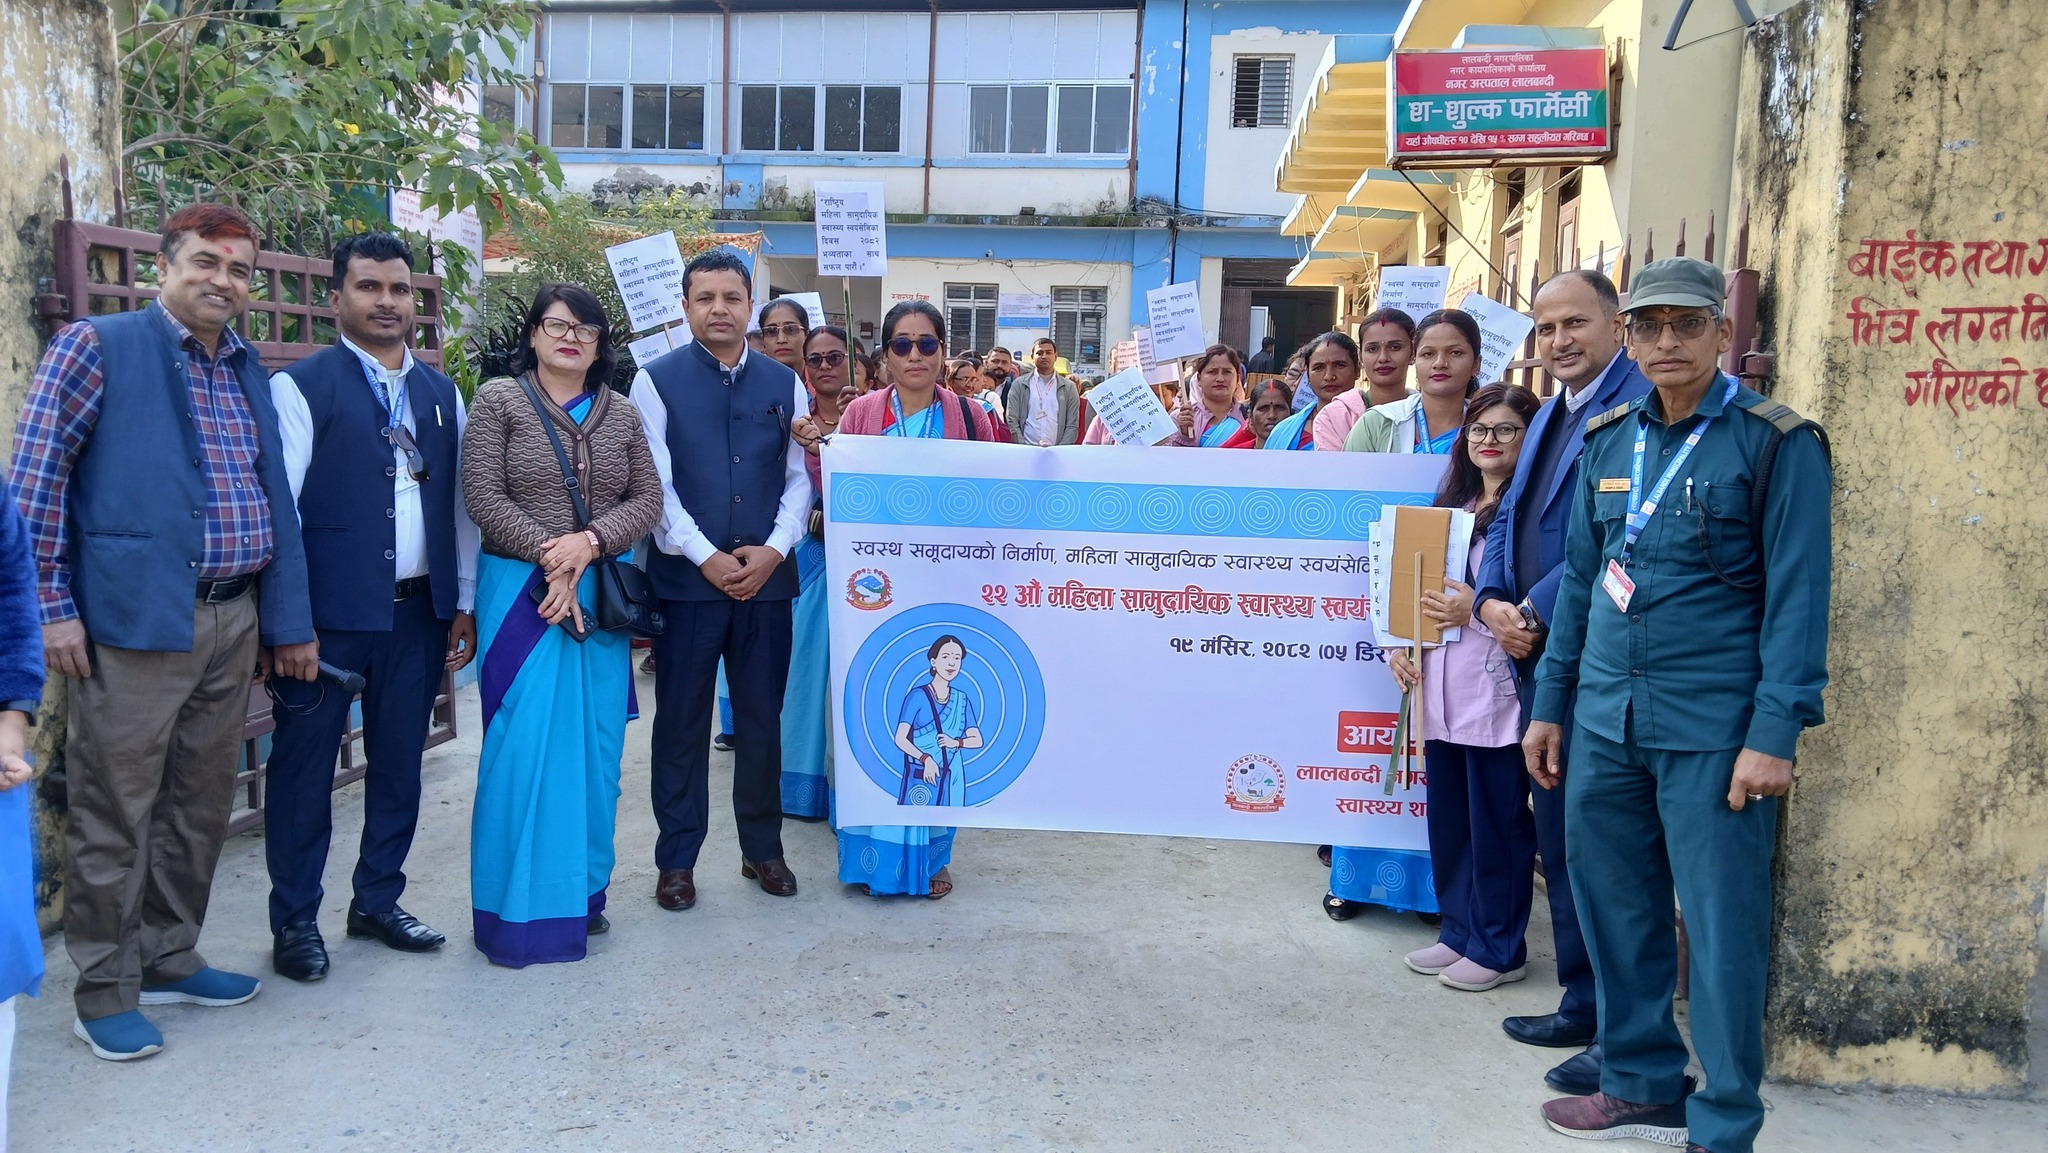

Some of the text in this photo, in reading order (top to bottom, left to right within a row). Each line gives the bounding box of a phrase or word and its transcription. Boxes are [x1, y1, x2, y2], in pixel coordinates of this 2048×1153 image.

[1450, 67, 1466, 75] नगर
[1518, 62, 1546, 72] कार्यालय
[1461, 53, 1534, 64] लालबन्दी नगरपालिका
[1445, 74, 1555, 89] नगर अस्पताल लालबन्दी
[1509, 91, 1592, 118] फार्मेसी
[1459, 135, 1468, 144] १०
[1470, 133, 1486, 144] देखि
[1508, 134, 1526, 143] सम्म
[821, 209, 878, 221] महिला सामुदायिक
[821, 235, 840, 245] दिवस
[1963, 240, 2029, 288] तथा
[1847, 296, 1920, 348] भित्र
[1905, 357, 2029, 417] गरिएको
[852, 540, 903, 557] स्वस्थ
[909, 541, 996, 564] समूदायको
[1002, 542, 1058, 565] निर्माण,
[1066, 546, 1118, 565] महिला
[1124, 550, 1217, 572] सामुदायिक
[1224, 555, 1292, 572] स्वास्थ्य
[981, 584, 1007, 606] २२
[1047, 579, 1116, 611] महिला
[1120, 585, 1231, 621] सामुदायिक
[1237, 593, 1316, 619] स्वास्थ्य
[1321, 594, 1370, 621] स्वयं
[1170, 637, 1194, 653] १९
[1201, 635, 1256, 658] मंसिर,
[1263, 642, 1311, 659] २०८२
[1319, 644, 1347, 662] (०५
[1296, 764, 1382, 784] लालबन्दी
[1336, 798, 1403, 815] स्वास्थ्य
